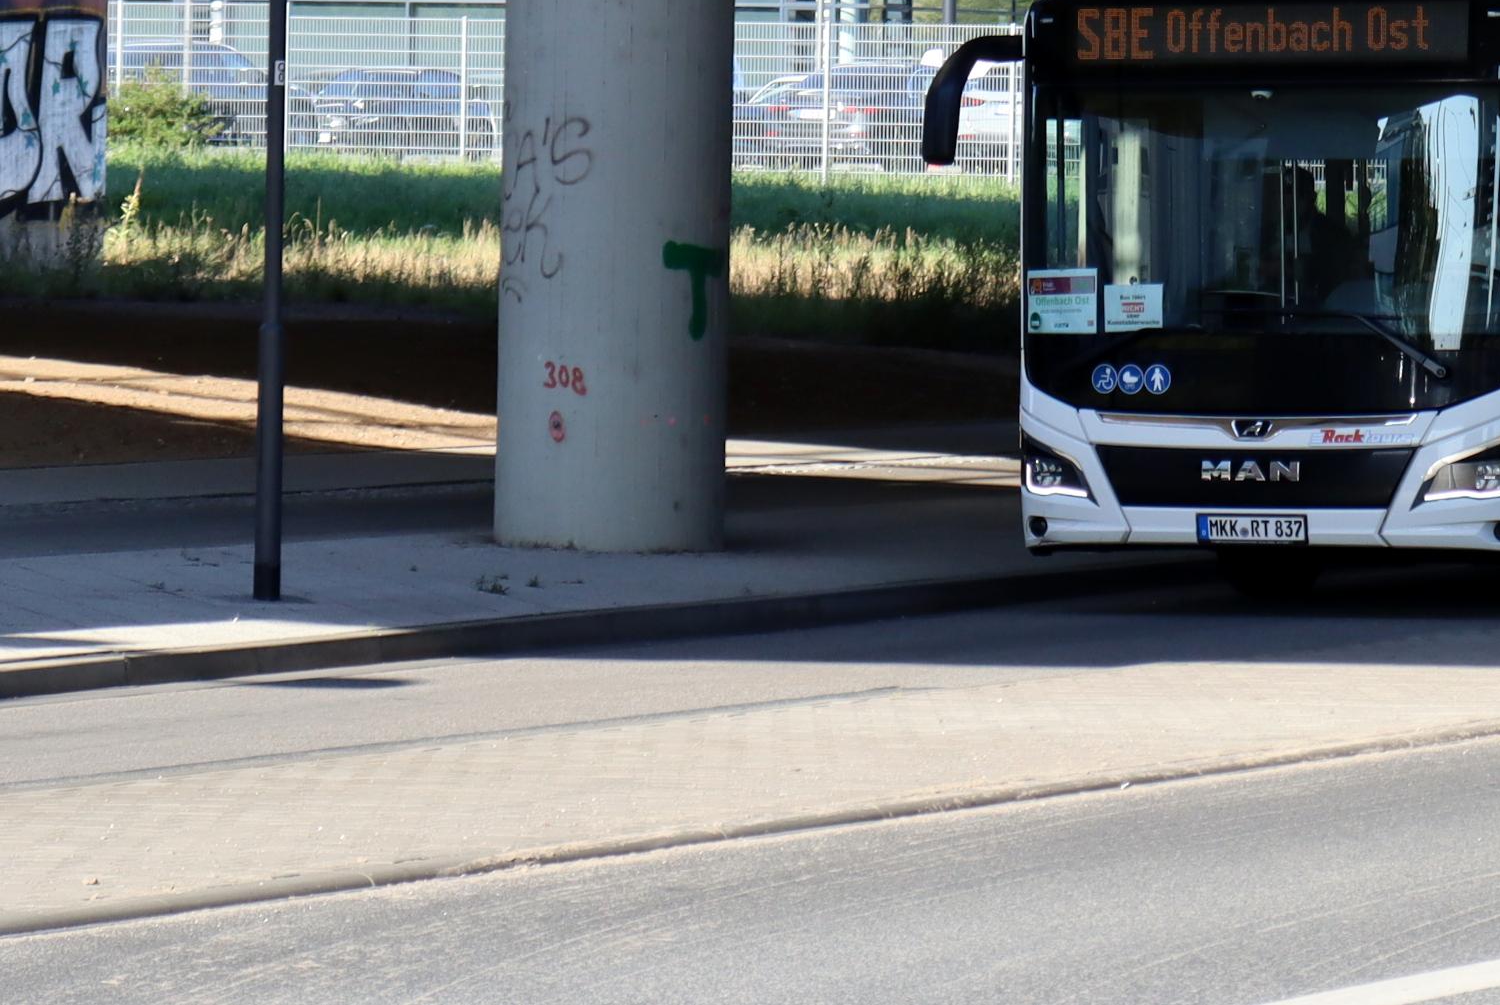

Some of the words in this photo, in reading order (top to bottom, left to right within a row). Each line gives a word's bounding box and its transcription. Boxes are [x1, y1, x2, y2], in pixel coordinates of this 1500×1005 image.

[1166, 6, 1352, 53] Offenbach
[1367, 5, 1429, 51] Ost
[1201, 460, 1300, 482] MAN
[1209, 519, 1239, 538] MKK
[1251, 520, 1271, 538] RT
[1275, 520, 1303, 537] 837
